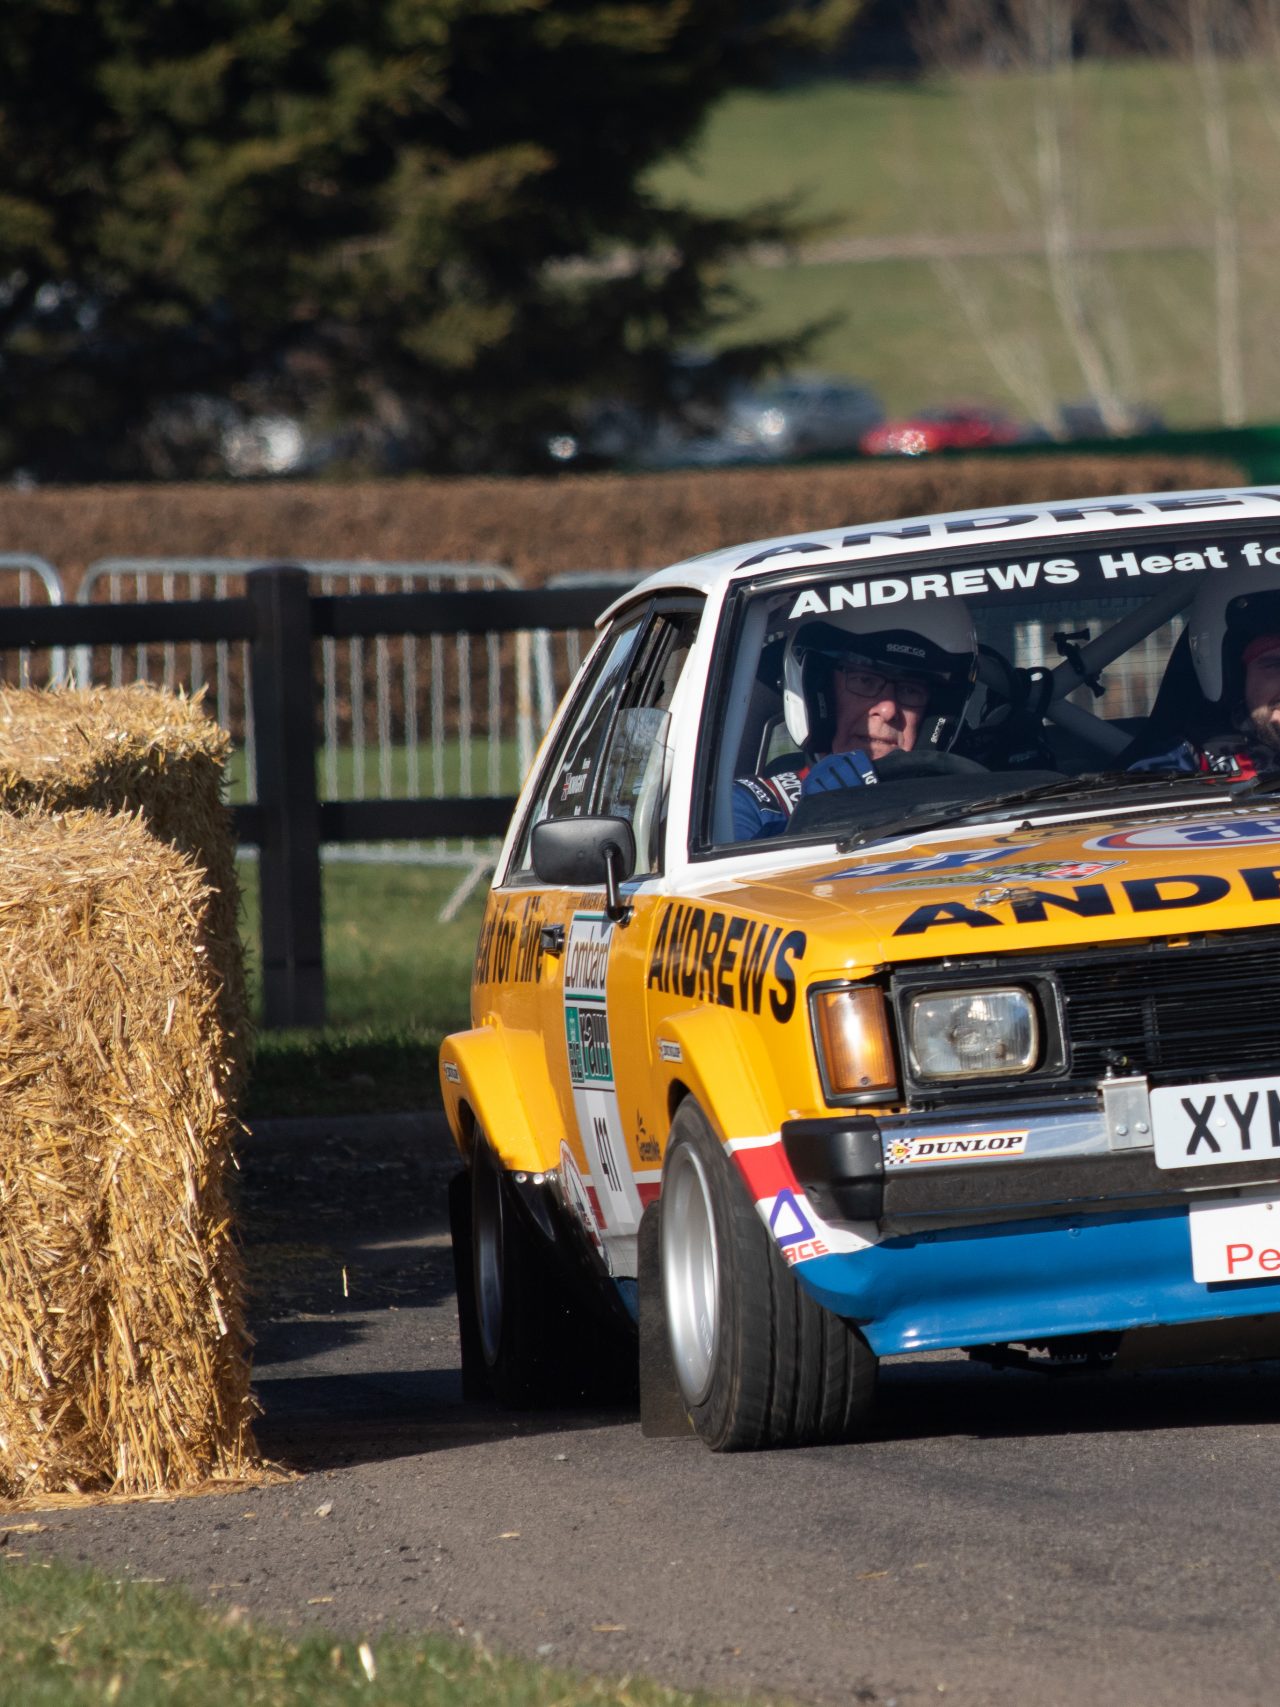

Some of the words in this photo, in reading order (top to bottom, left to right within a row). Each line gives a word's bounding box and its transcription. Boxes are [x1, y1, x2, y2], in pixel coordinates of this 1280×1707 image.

[788, 559, 1080, 620] ANDREWS
[1099, 546, 1228, 579] Heat
[492, 896, 518, 984] for
[514, 895, 545, 984] Hire
[647, 902, 807, 1024] ANDREWS
[915, 1136, 1023, 1156] DUNLOP
[783, 1240, 829, 1264] ACE
